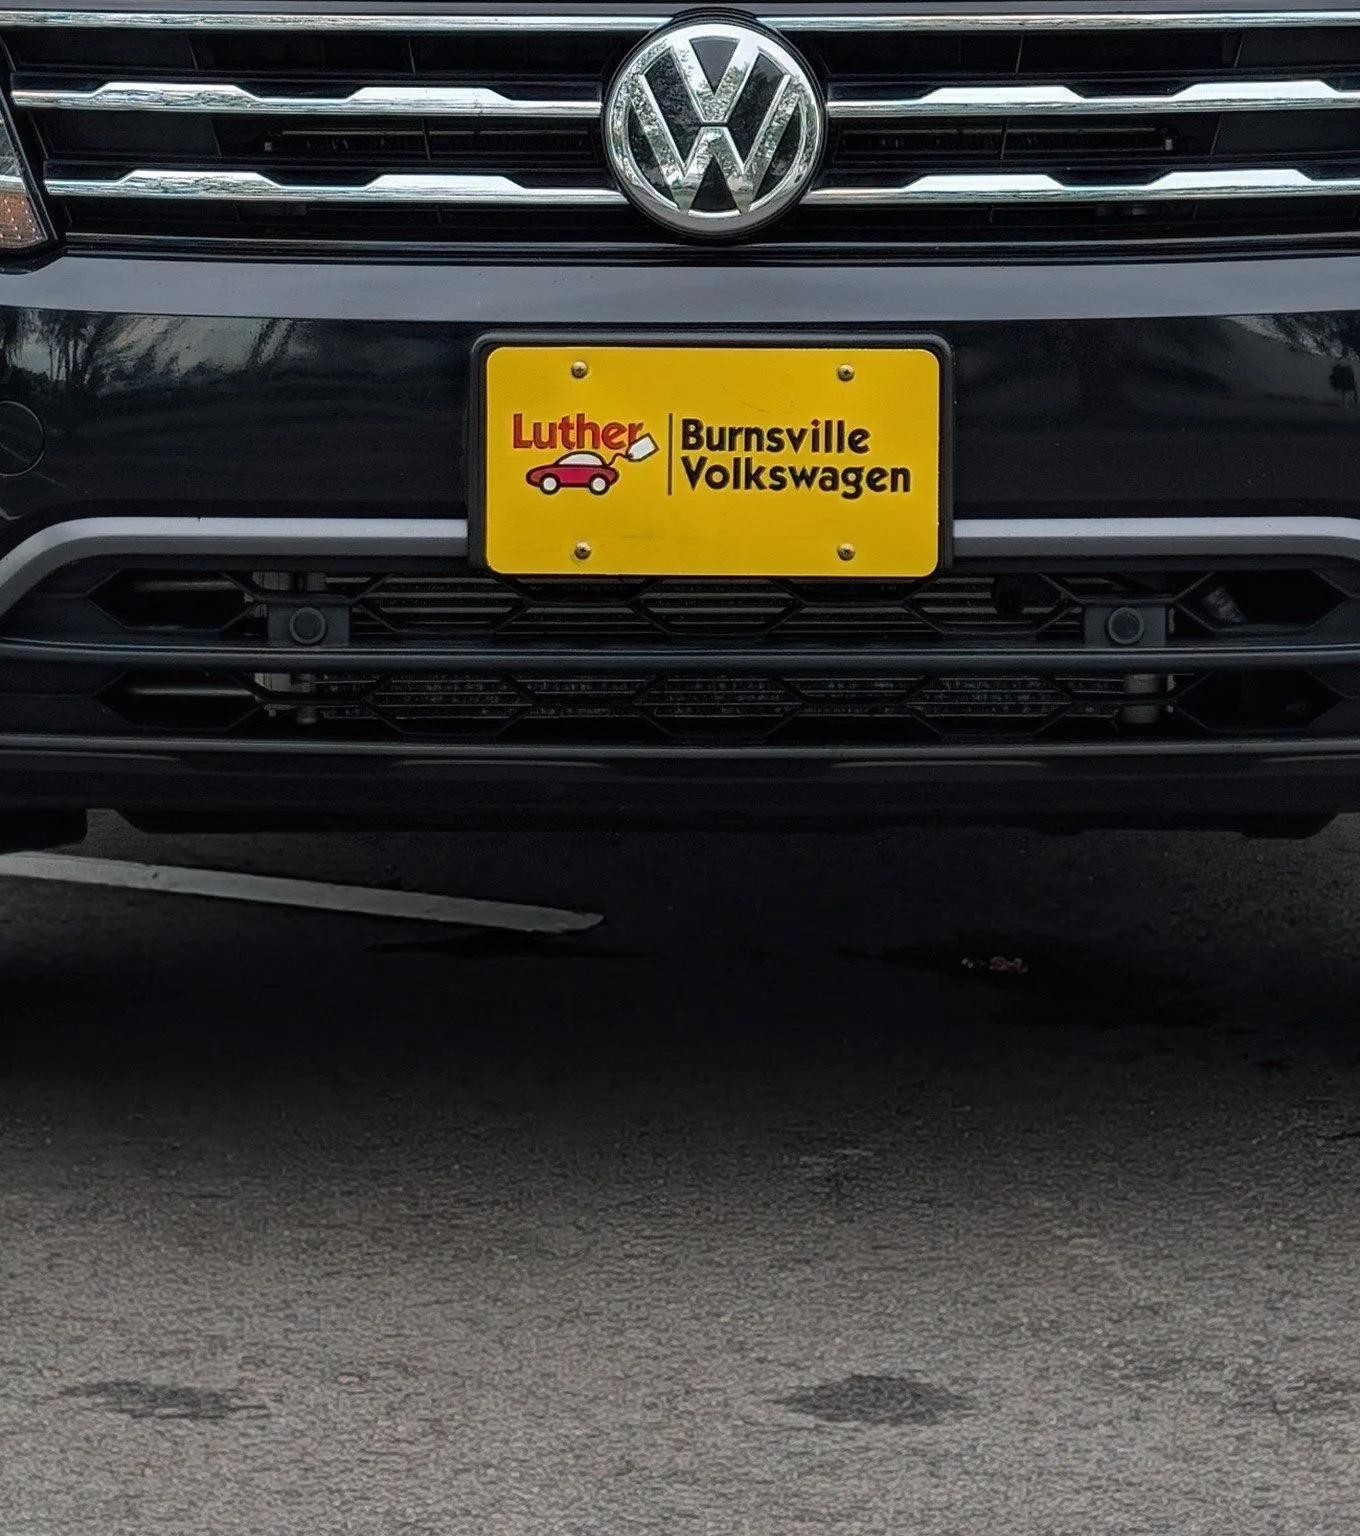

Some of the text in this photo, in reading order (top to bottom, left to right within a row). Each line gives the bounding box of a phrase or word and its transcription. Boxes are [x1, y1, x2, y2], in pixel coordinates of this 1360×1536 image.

[512, 412, 644, 451] Luther
[681, 419, 871, 454] Burnsville
[681, 455, 912, 500] Volkswagen
